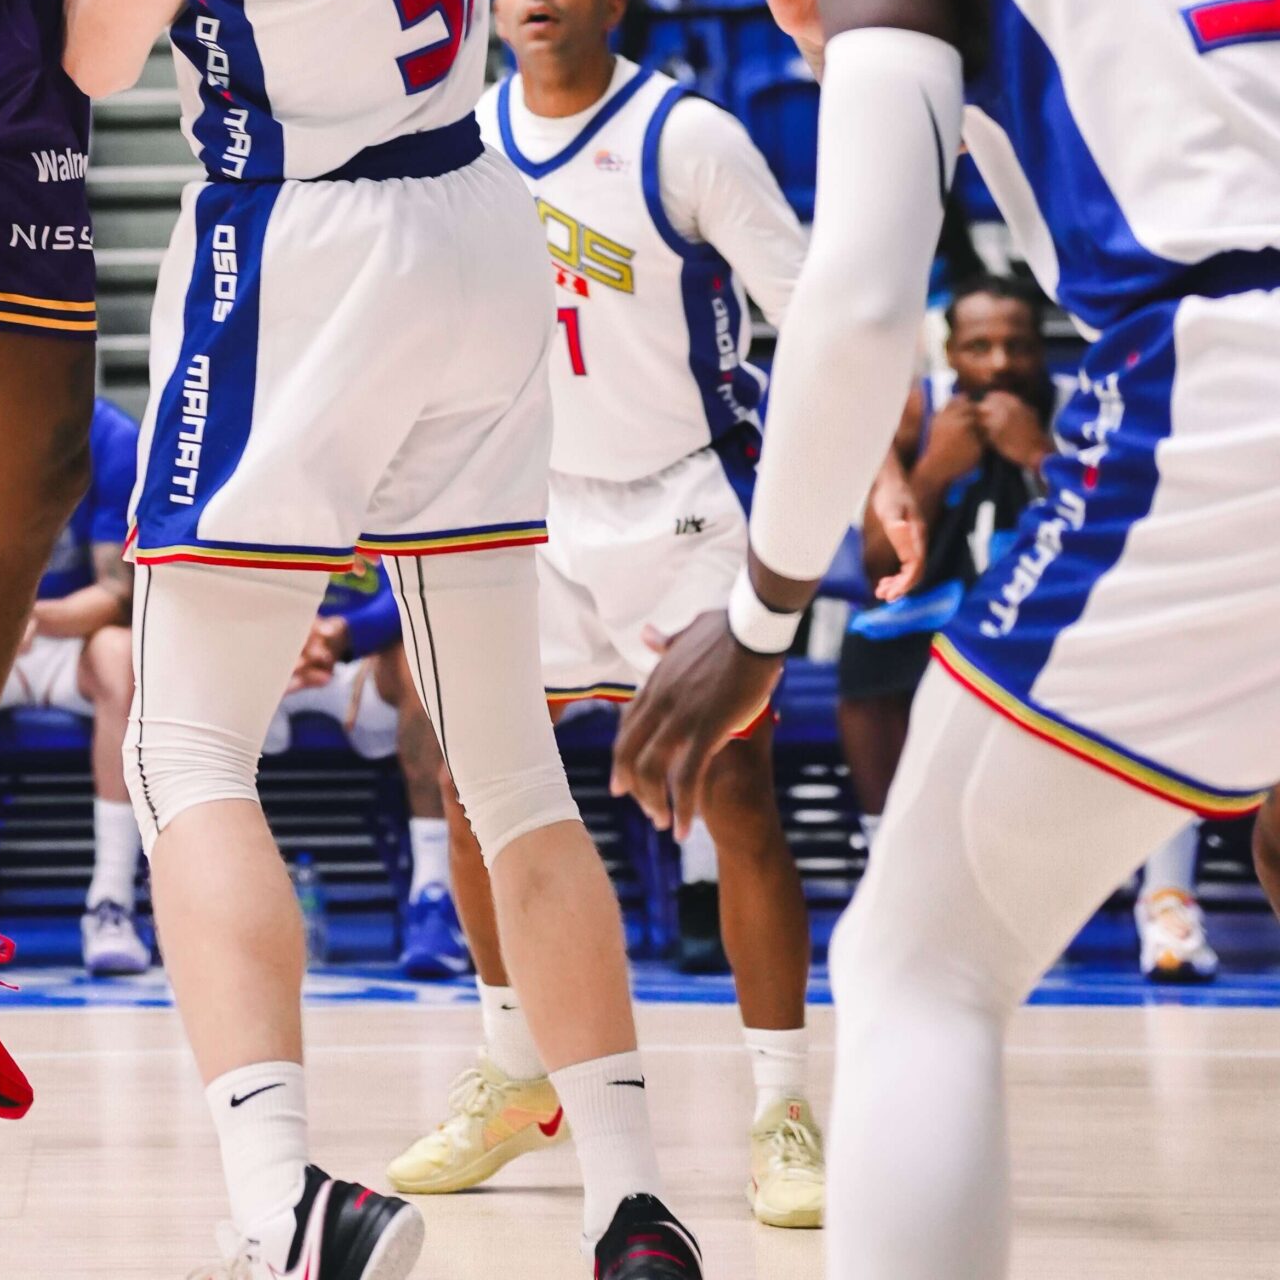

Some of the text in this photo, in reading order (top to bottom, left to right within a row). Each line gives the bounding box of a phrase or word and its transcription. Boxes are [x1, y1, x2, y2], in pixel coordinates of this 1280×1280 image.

[221, 107, 252, 180] MAN
[169, 224, 238, 505] OSOS MANATI
